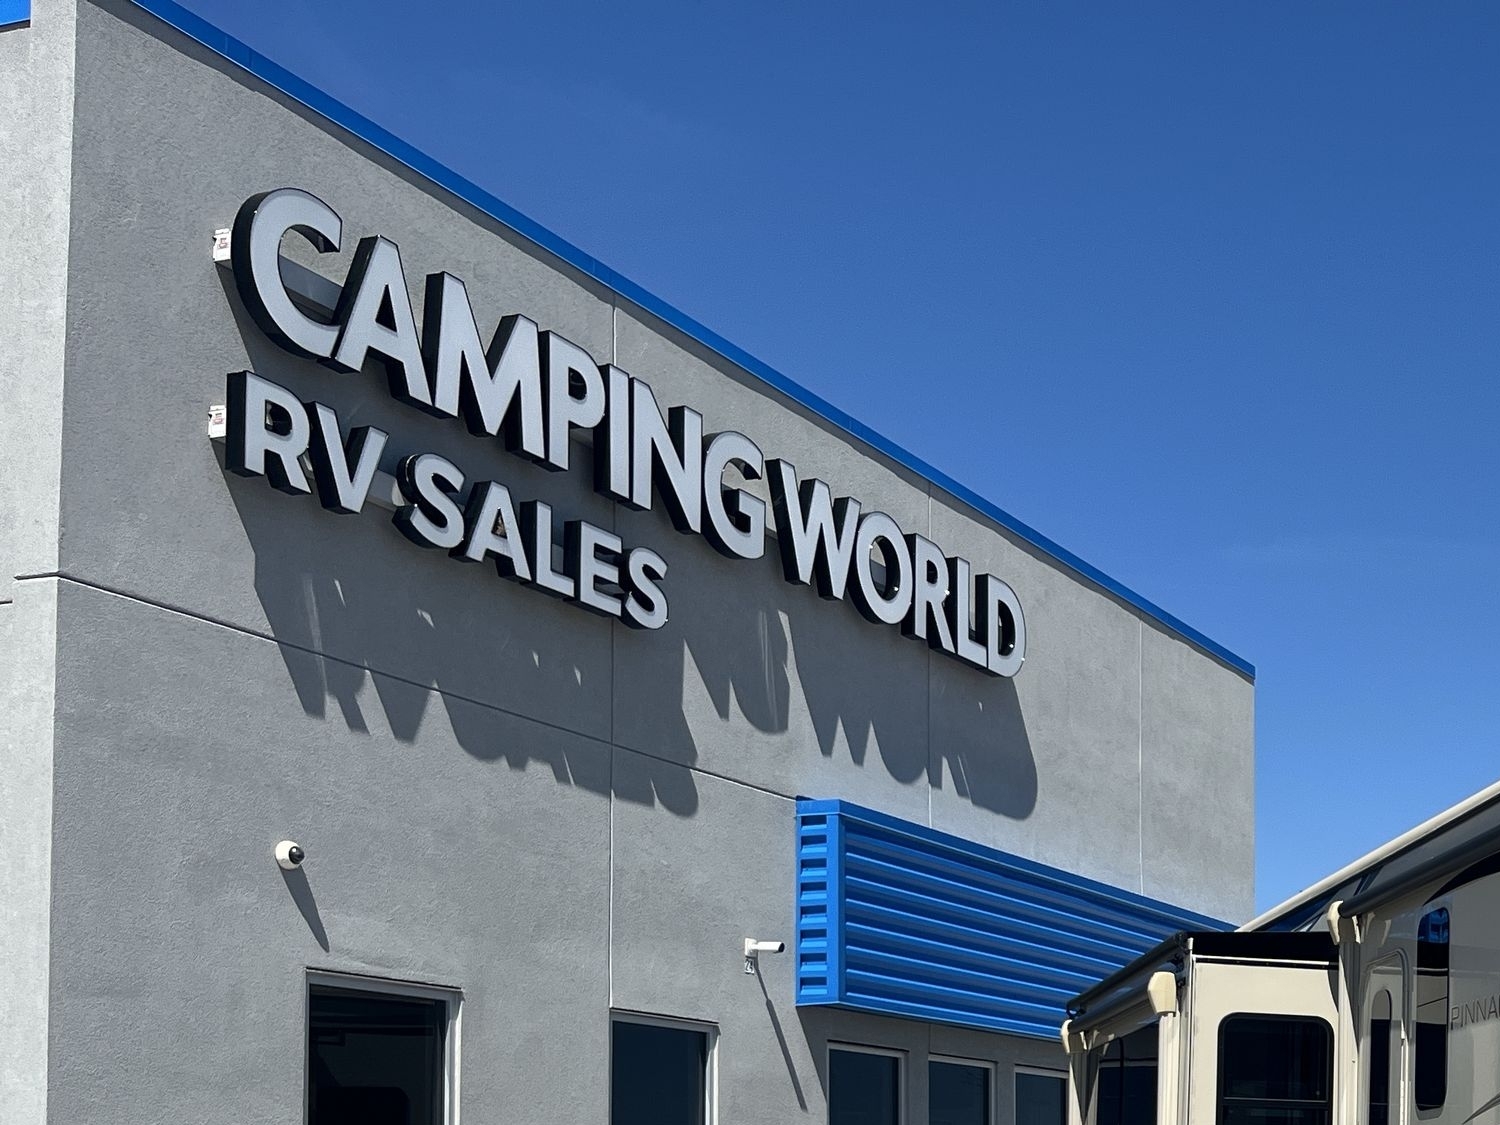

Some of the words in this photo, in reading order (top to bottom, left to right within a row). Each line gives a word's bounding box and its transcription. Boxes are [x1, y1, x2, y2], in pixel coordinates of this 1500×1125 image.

[227, 370, 389, 514] RV
[394, 452, 668, 630] SALES
[234, 187, 767, 560] CAMPING
[768, 457, 1027, 678] WORLD
